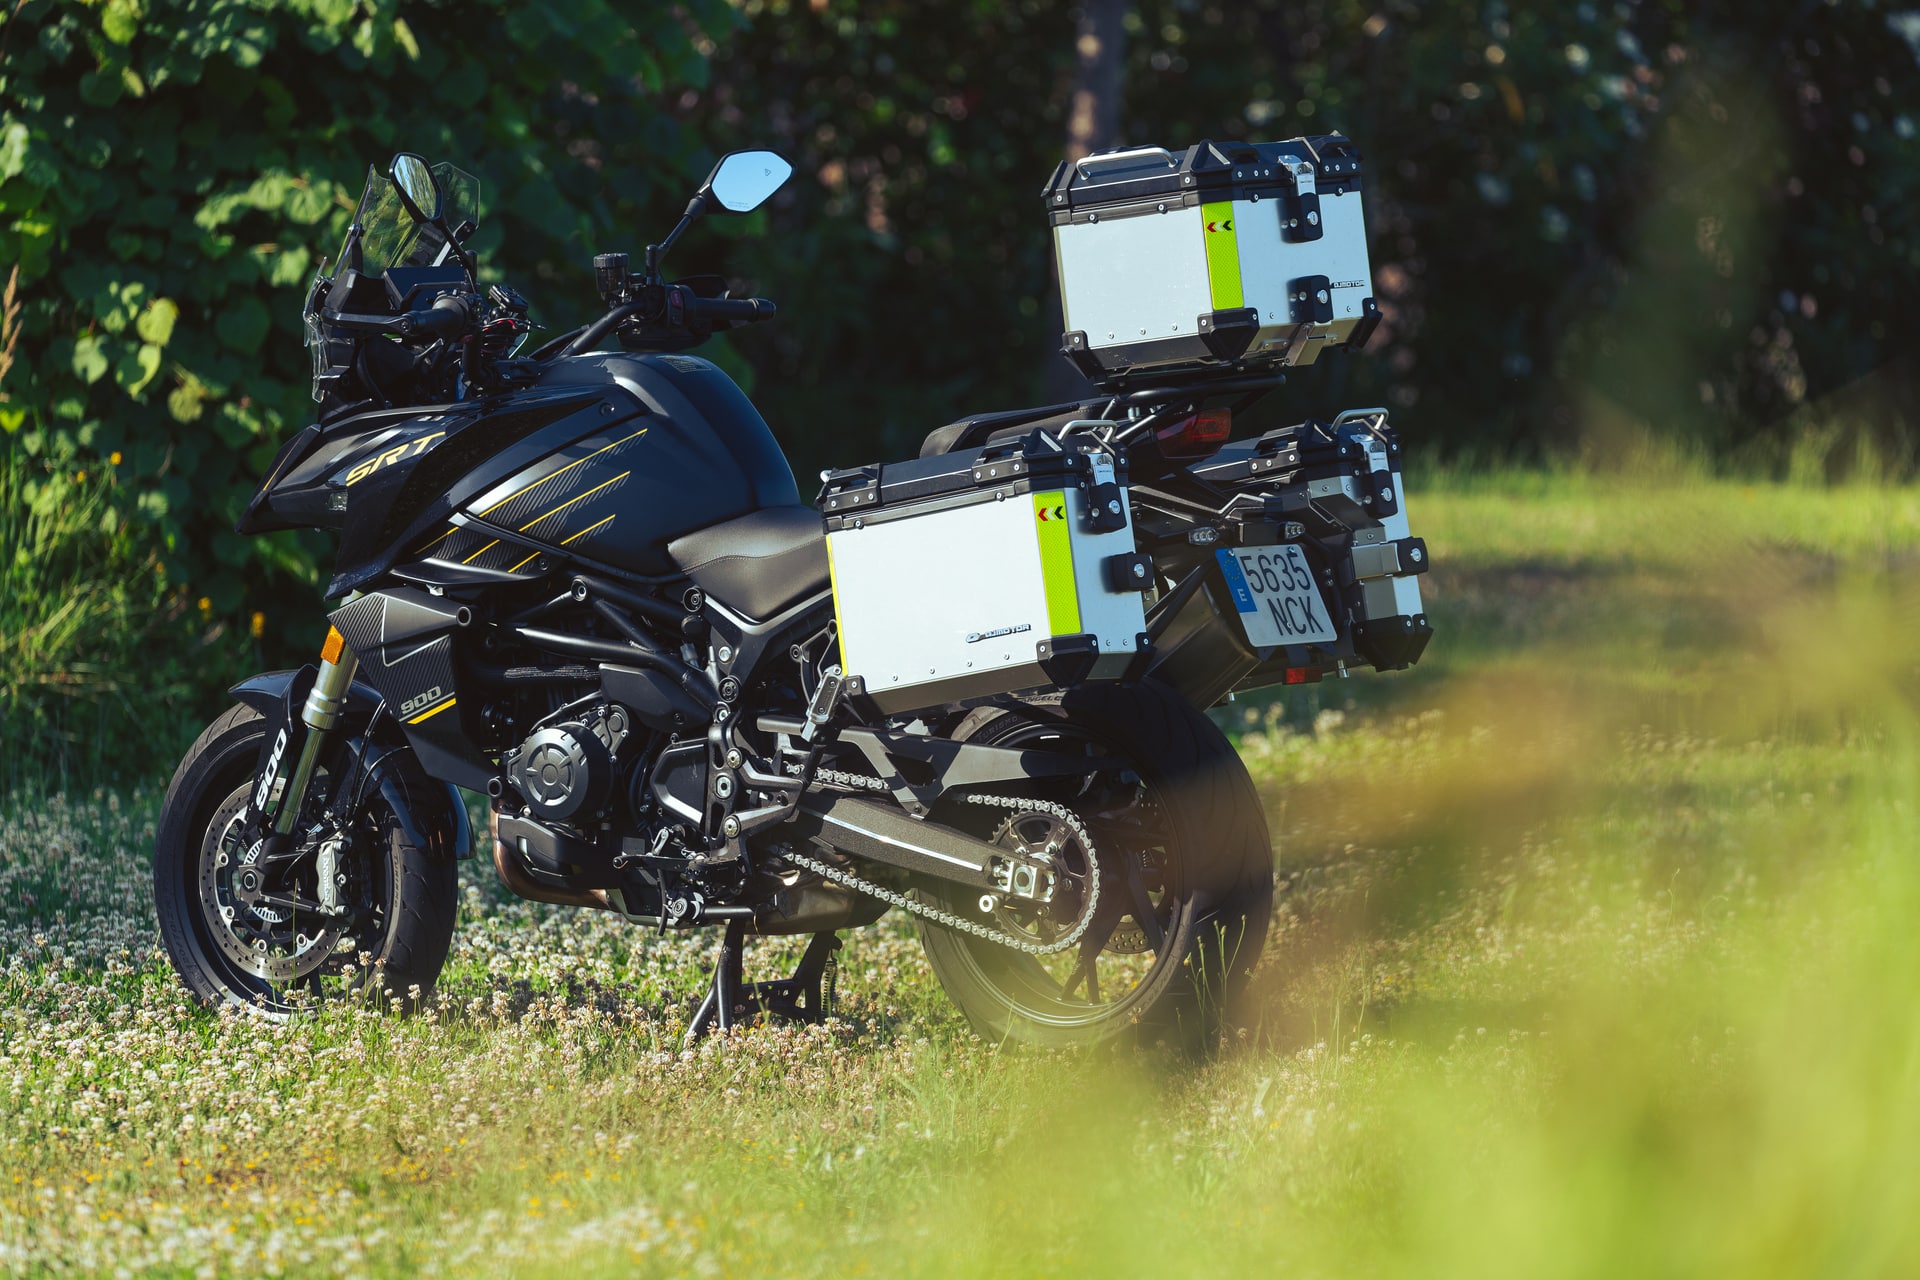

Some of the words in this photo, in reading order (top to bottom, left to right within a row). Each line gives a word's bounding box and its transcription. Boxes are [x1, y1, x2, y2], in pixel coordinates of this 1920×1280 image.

[346, 431, 446, 487] SRT
[1240, 552, 1311, 594] 5635
[1267, 596, 1324, 636] NCK
[400, 685, 442, 715] 900
[256, 728, 287, 811] 900
